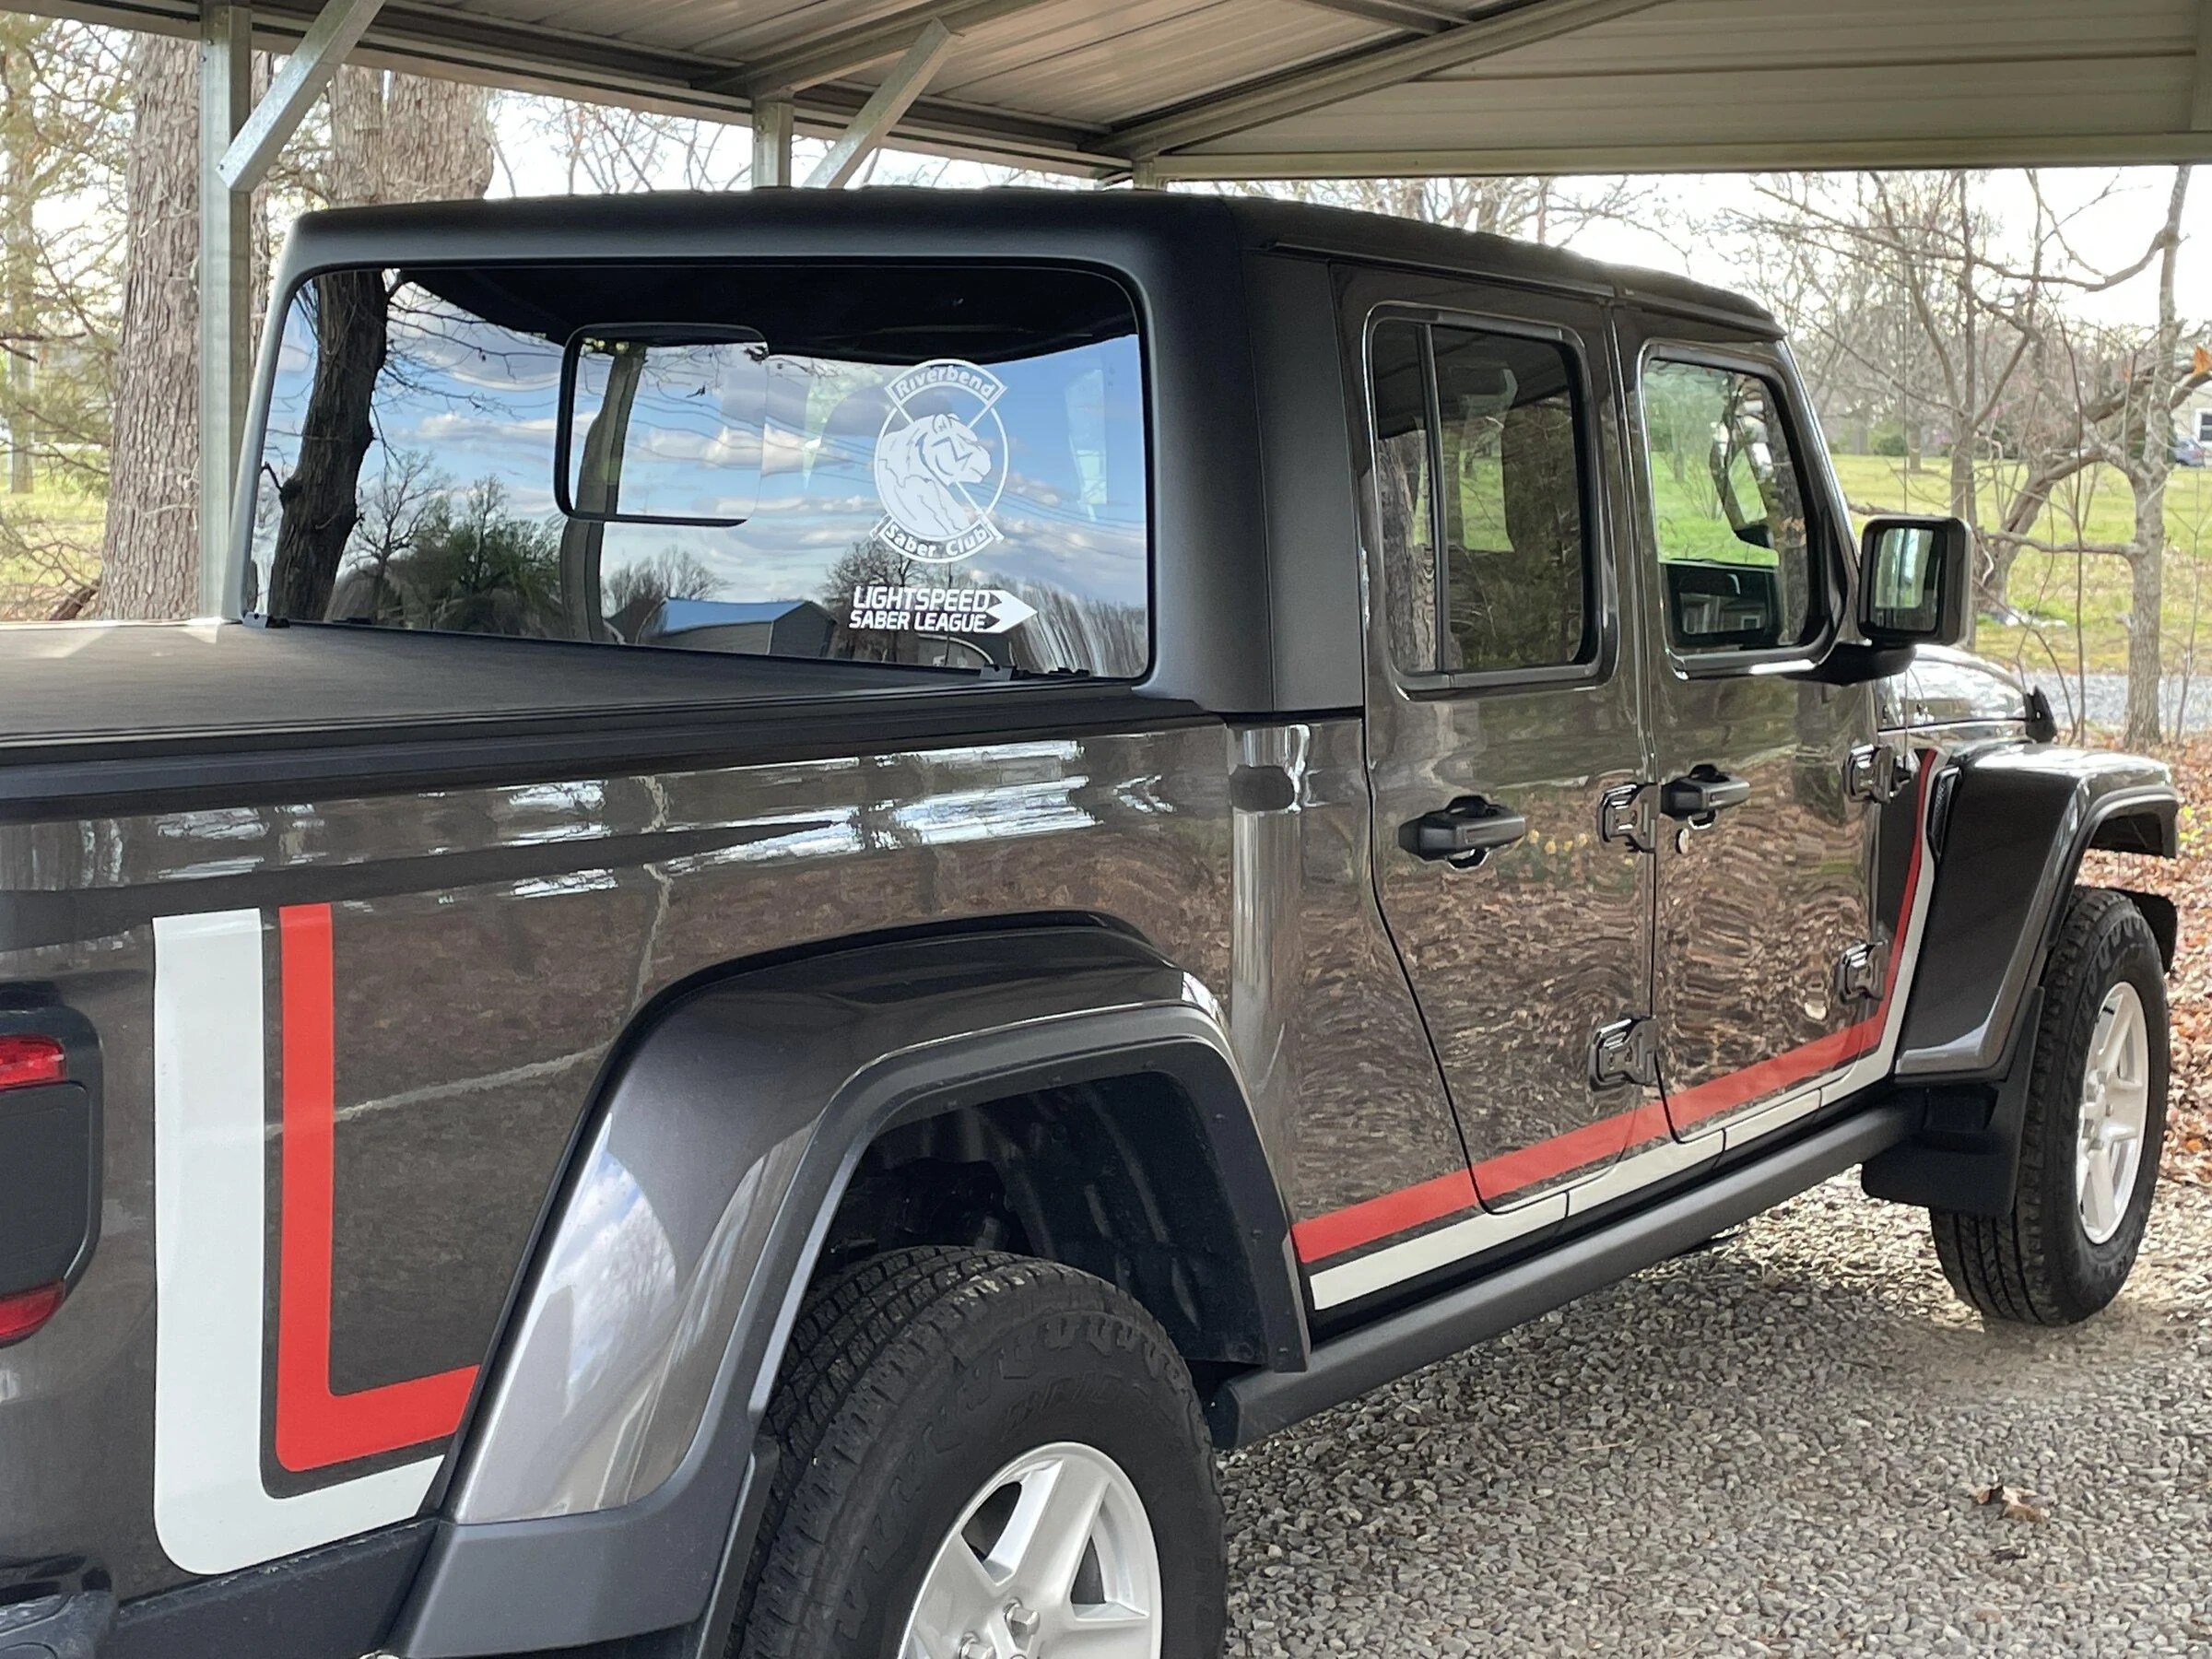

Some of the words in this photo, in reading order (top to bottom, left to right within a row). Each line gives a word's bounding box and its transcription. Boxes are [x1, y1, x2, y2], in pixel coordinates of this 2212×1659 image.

[894, 365, 995, 398] Riverbend
[886, 524, 935, 558] Saber
[946, 524, 992, 556] Club
[853, 586, 990, 612] LIGHTSPEED
[849, 609, 910, 630] SABER
[913, 612, 987, 633] LEAGUE
